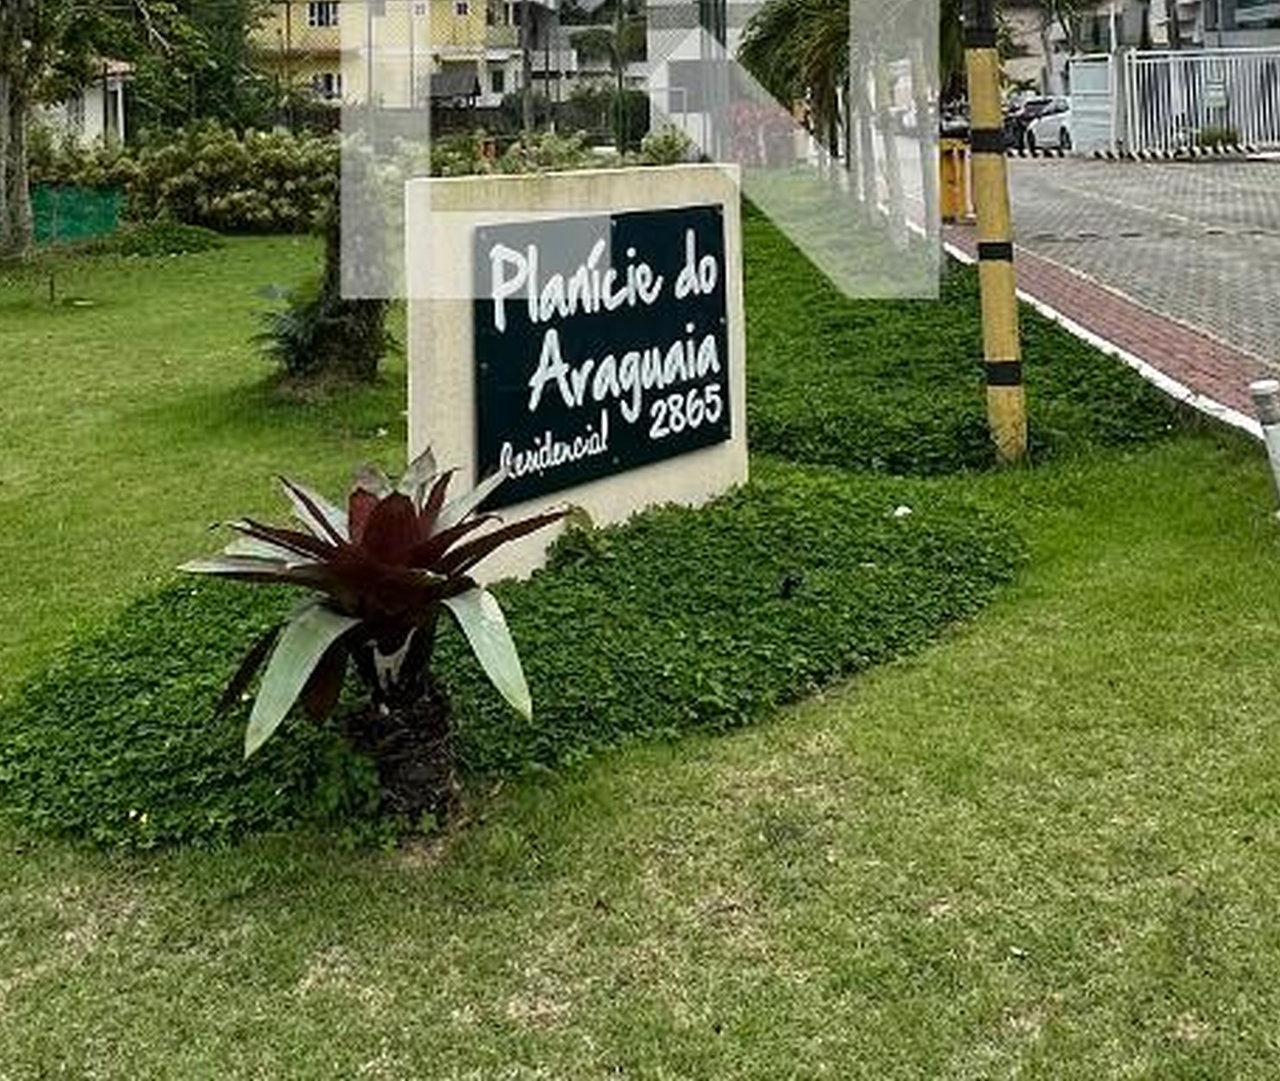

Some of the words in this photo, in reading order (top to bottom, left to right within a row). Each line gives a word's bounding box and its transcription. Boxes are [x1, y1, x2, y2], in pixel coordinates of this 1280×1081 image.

[489, 237, 663, 333] Planície
[675, 228, 717, 299] do
[528, 322, 721, 423] Araguaia
[649, 383, 722, 439] 2865
